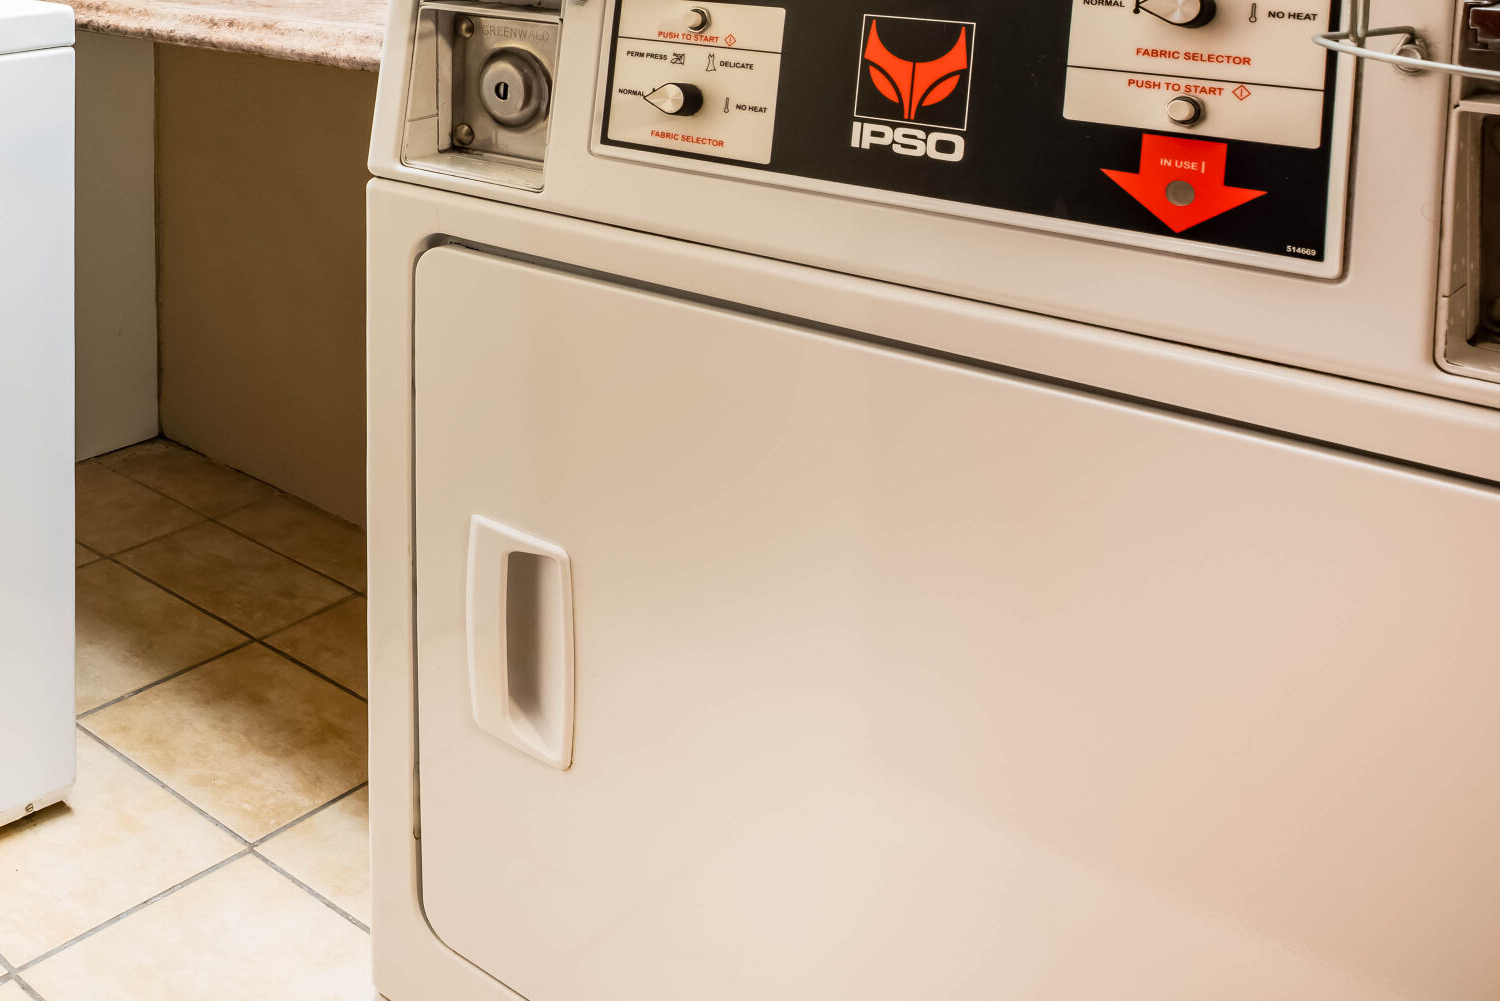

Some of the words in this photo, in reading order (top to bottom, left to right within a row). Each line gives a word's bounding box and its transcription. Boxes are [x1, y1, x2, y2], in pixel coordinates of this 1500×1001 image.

[1267, 10, 1286, 19] NO
[1288, 12, 1318, 22] HEAT
[658, 31, 680, 40] PUSH
[682, 33, 692, 41] TO
[694, 34, 720, 43] START
[626, 50, 644, 58] PERM
[646, 52, 668, 60] PRESS
[1136, 47, 1181, 60] FABRIC
[1184, 52, 1251, 66] SELECTOR
[720, 60, 754, 70] DELICATE
[618, 88, 645, 97] NORMAL
[1128, 79, 1161, 90] PUSH
[1165, 82, 1181, 92] TO
[1184, 84, 1224, 96] START
[748, 105, 768, 114] HEAT
[651, 130, 679, 141] FABRIC
[681, 134, 724, 148] SELECTOR
[850, 121, 966, 163] IPSO
[1160, 158, 1172, 167] IN
[1174, 160, 1198, 171] USE
[1286, 245, 1317, 256] 514669
